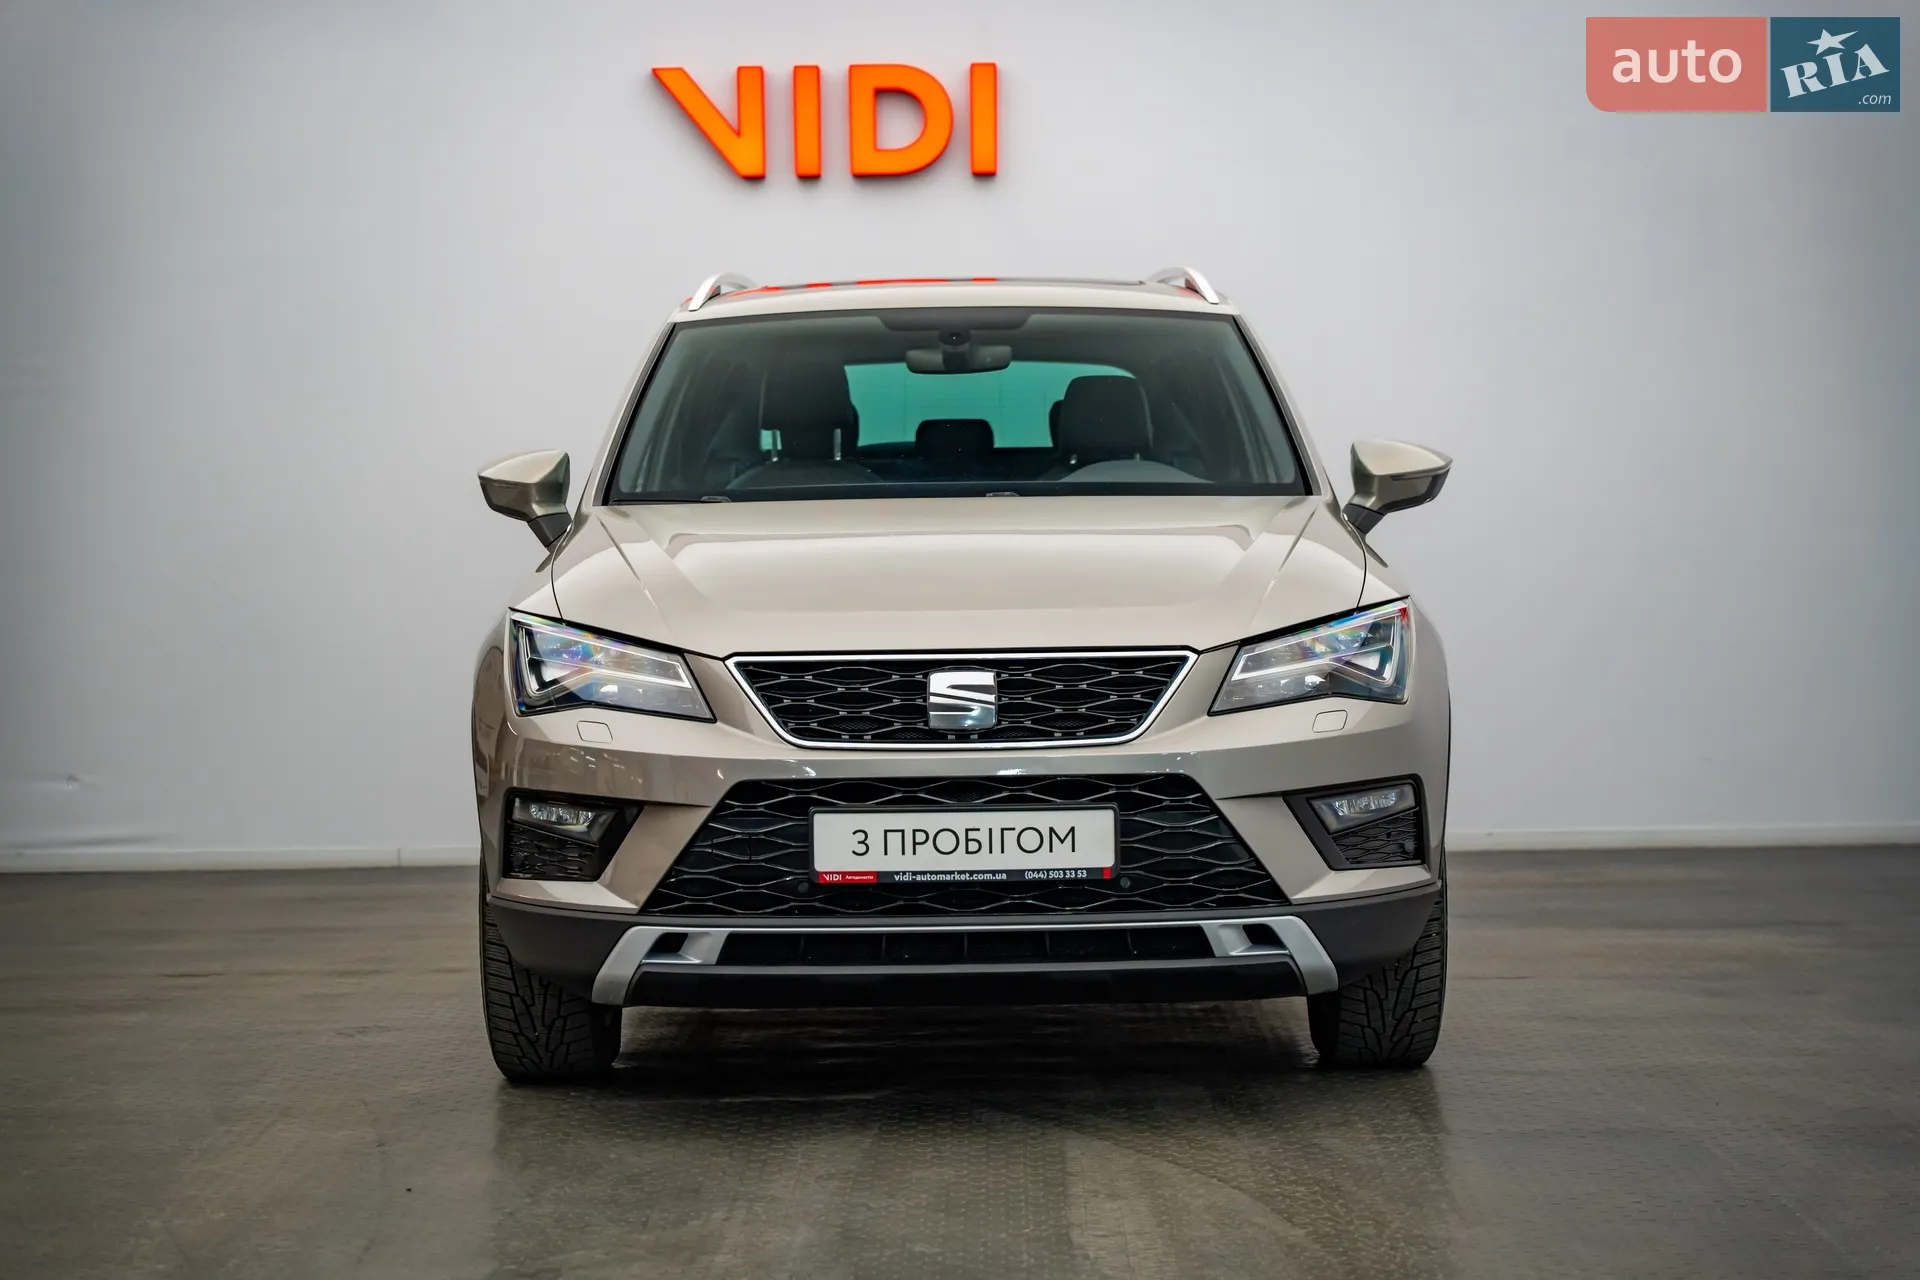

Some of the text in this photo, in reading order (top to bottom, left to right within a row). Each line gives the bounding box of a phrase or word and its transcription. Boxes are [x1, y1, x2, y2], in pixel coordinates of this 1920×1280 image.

[651, 62, 997, 180] VIDI
[851, 826, 1076, 856] З ПРОБІГОМ
[823, 873, 842, 881] VIDI
[894, 872, 1007, 881] vidi-automarket.com.ua
[1024, 869, 1087, 879] (044) 503 33 53
